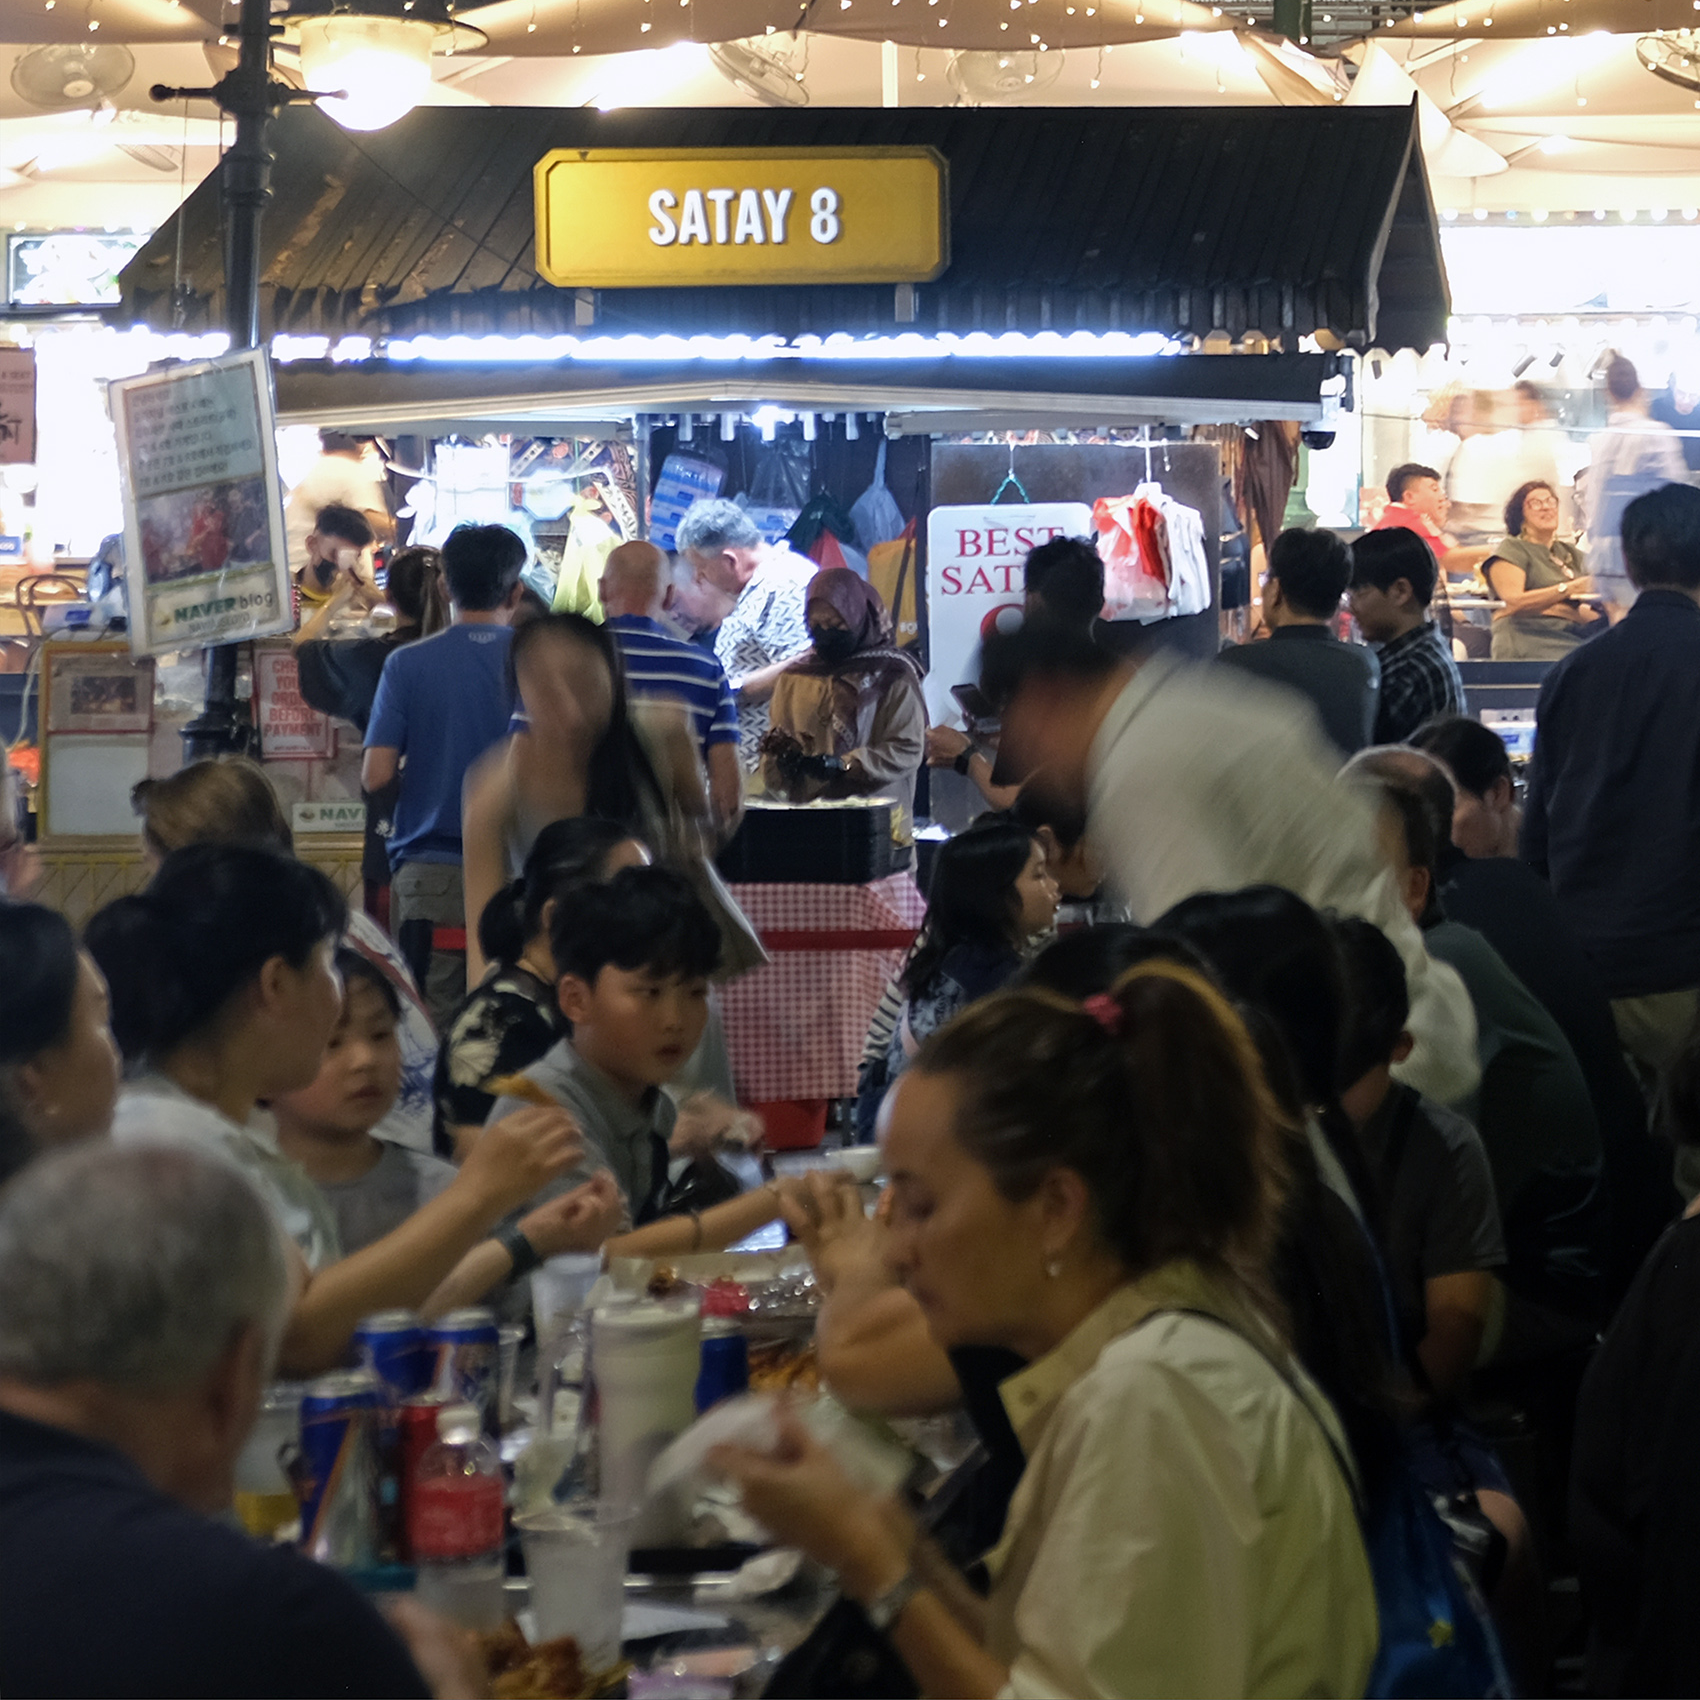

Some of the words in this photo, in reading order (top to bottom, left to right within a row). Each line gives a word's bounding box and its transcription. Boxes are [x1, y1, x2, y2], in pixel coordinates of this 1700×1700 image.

[648, 187, 793, 246] SATAY
[810, 187, 840, 244] 8
[941, 565, 1026, 596] SAT
[174, 597, 236, 623] NAVER
[239, 593, 273, 609] blog
[272, 660, 299, 676] CHE
[271, 691, 304, 707] ORD
[269, 707, 318, 723] BEFORE
[264, 723, 323, 738] PAYMENT
[319, 807, 366, 821] NAV
